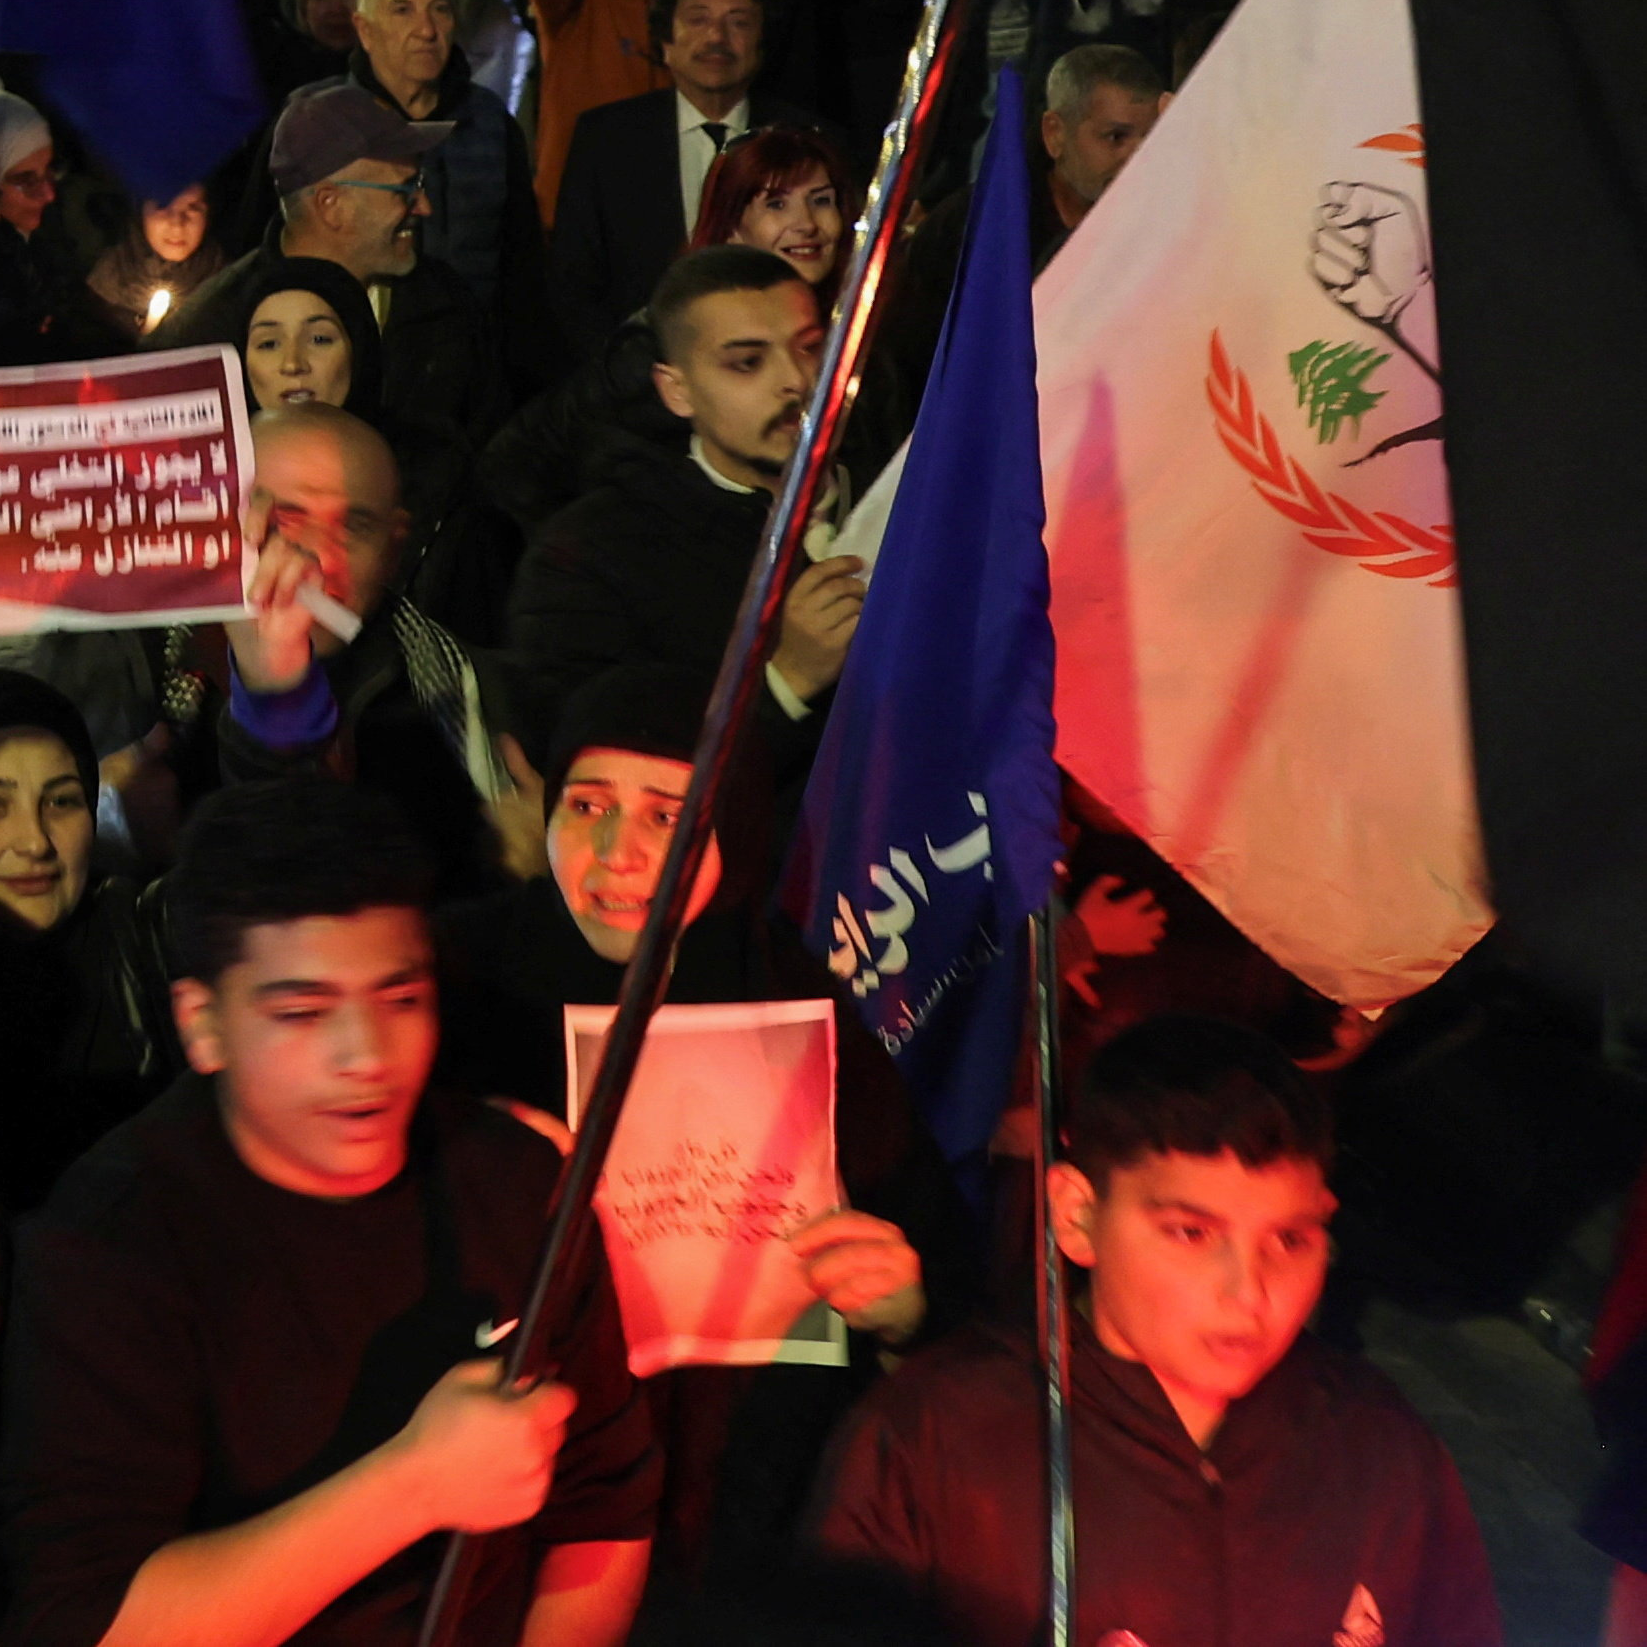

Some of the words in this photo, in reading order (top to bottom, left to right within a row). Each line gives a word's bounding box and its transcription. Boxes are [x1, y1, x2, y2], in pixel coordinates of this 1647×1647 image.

[30, 450, 124, 503] التخلي
[134, 450, 202, 492] يجوز
[210, 438, 228, 476] لا
